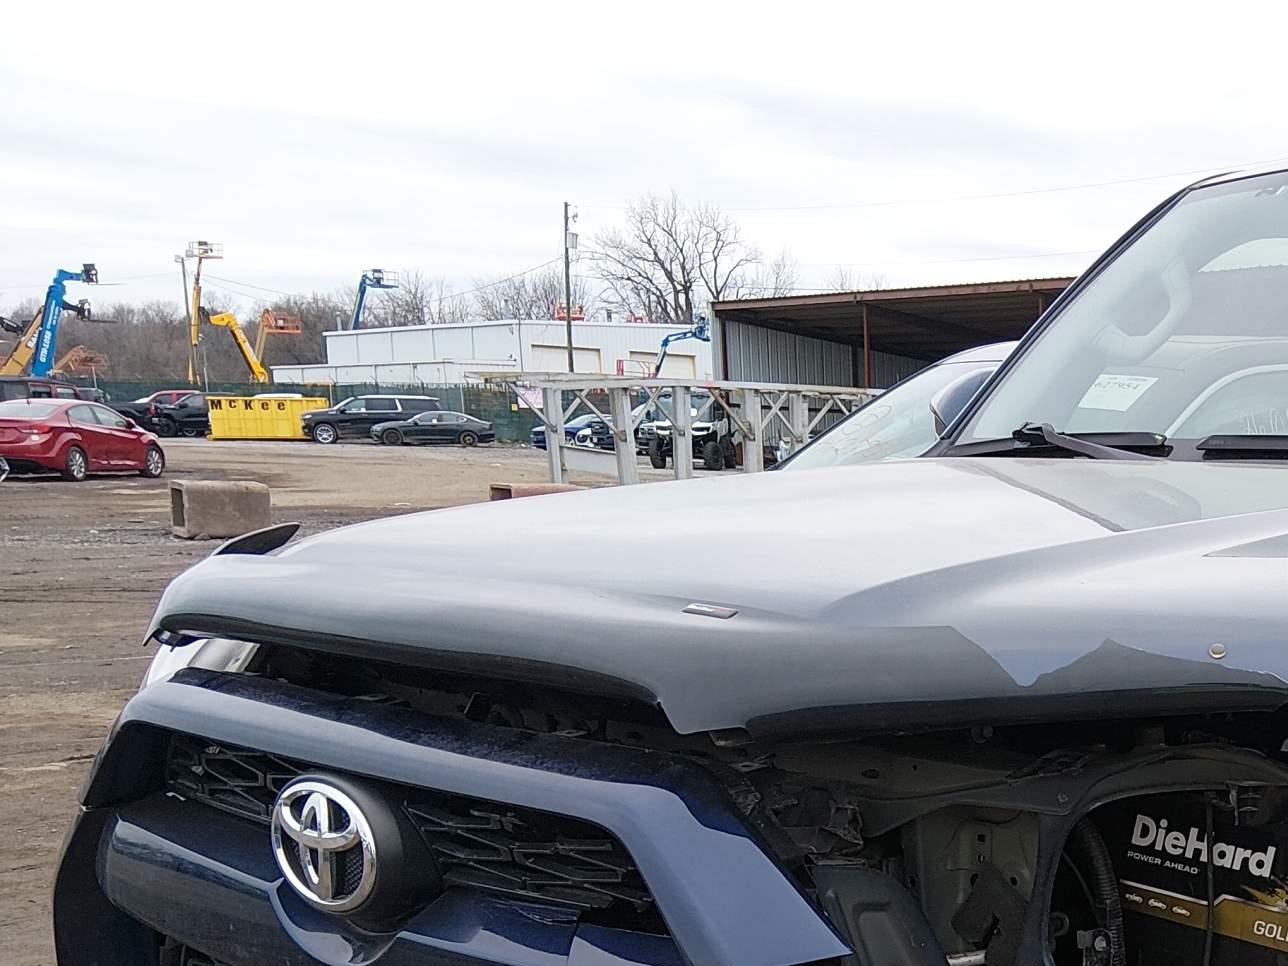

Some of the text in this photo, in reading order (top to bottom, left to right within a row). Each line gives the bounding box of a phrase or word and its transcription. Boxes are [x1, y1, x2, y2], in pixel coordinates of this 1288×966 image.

[1127, 851, 1200, 875] POWER AHEAD
[1131, 814, 1277, 878] DieHard
